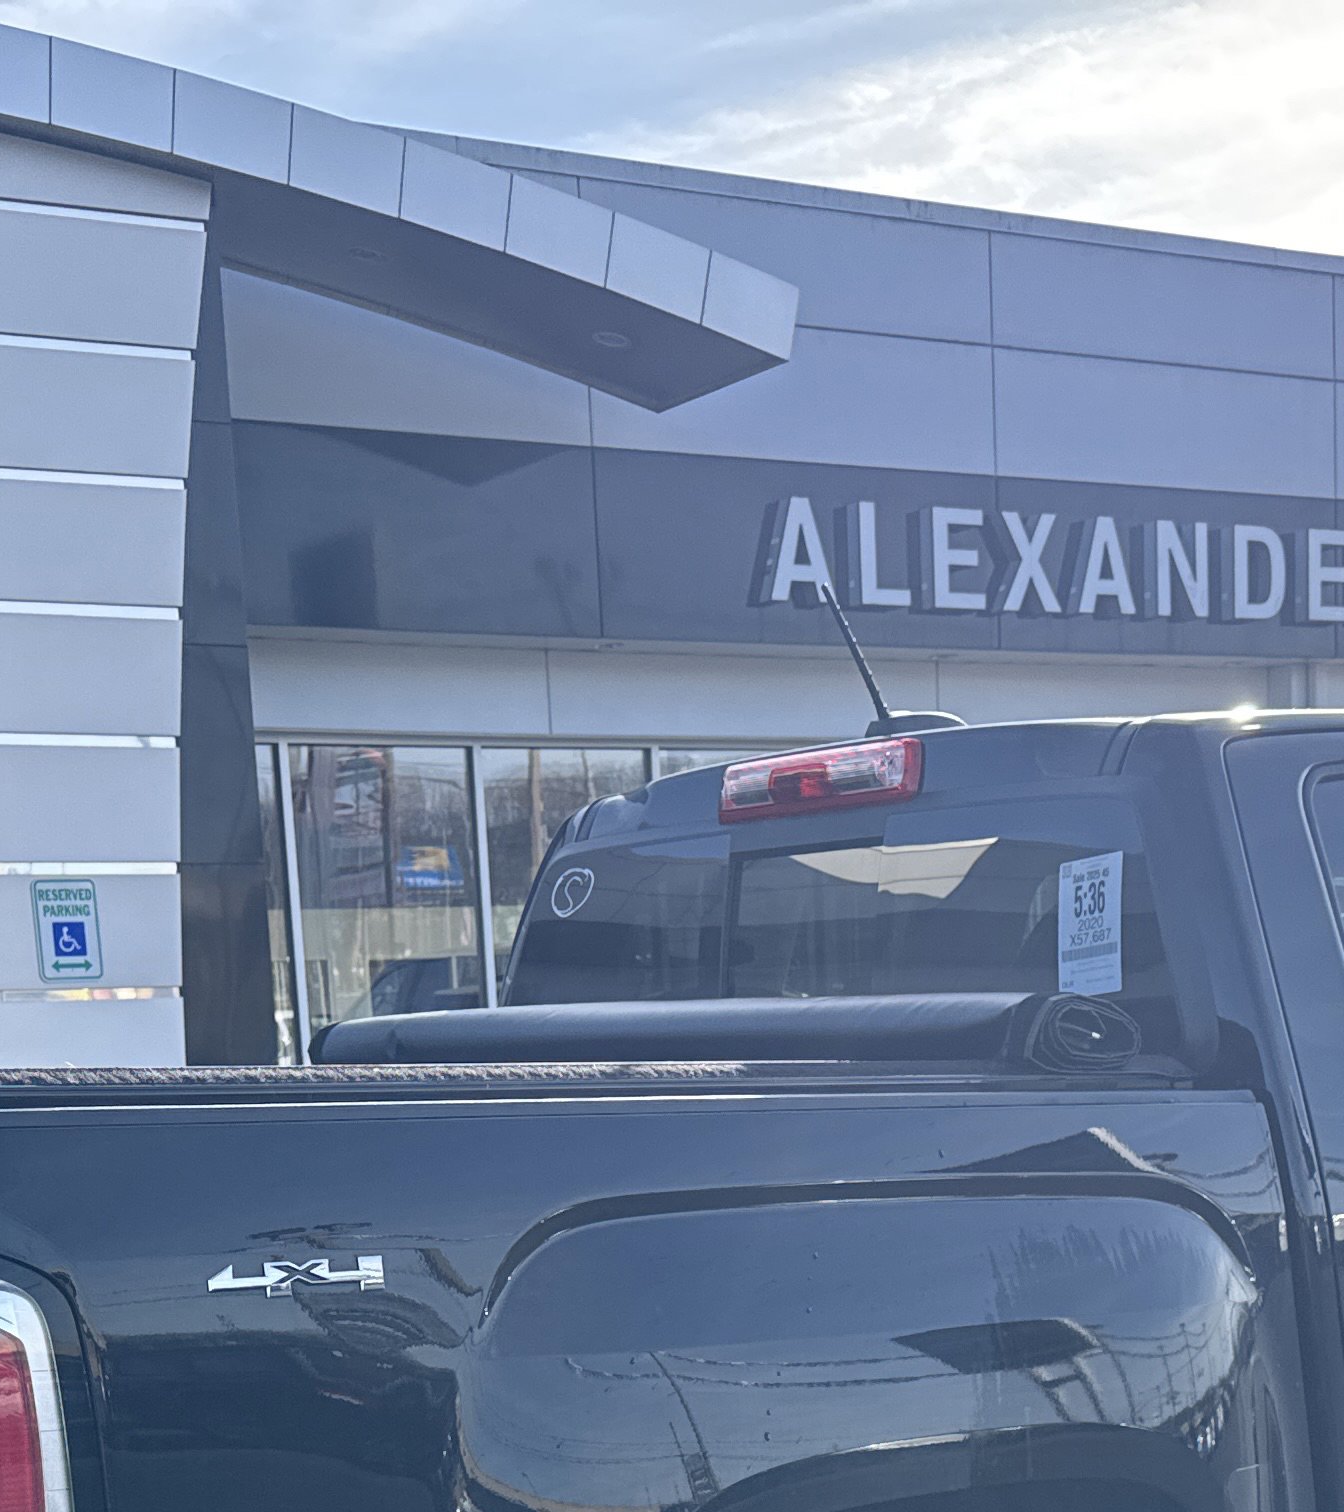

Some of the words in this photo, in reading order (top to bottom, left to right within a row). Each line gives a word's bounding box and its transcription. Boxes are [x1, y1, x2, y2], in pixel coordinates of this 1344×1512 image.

[37, 888, 92, 901] RESERVED
[1074, 880, 1106, 918] 5:36
[43, 904, 91, 917] PARKING
[1078, 916, 1104, 932] 2020
